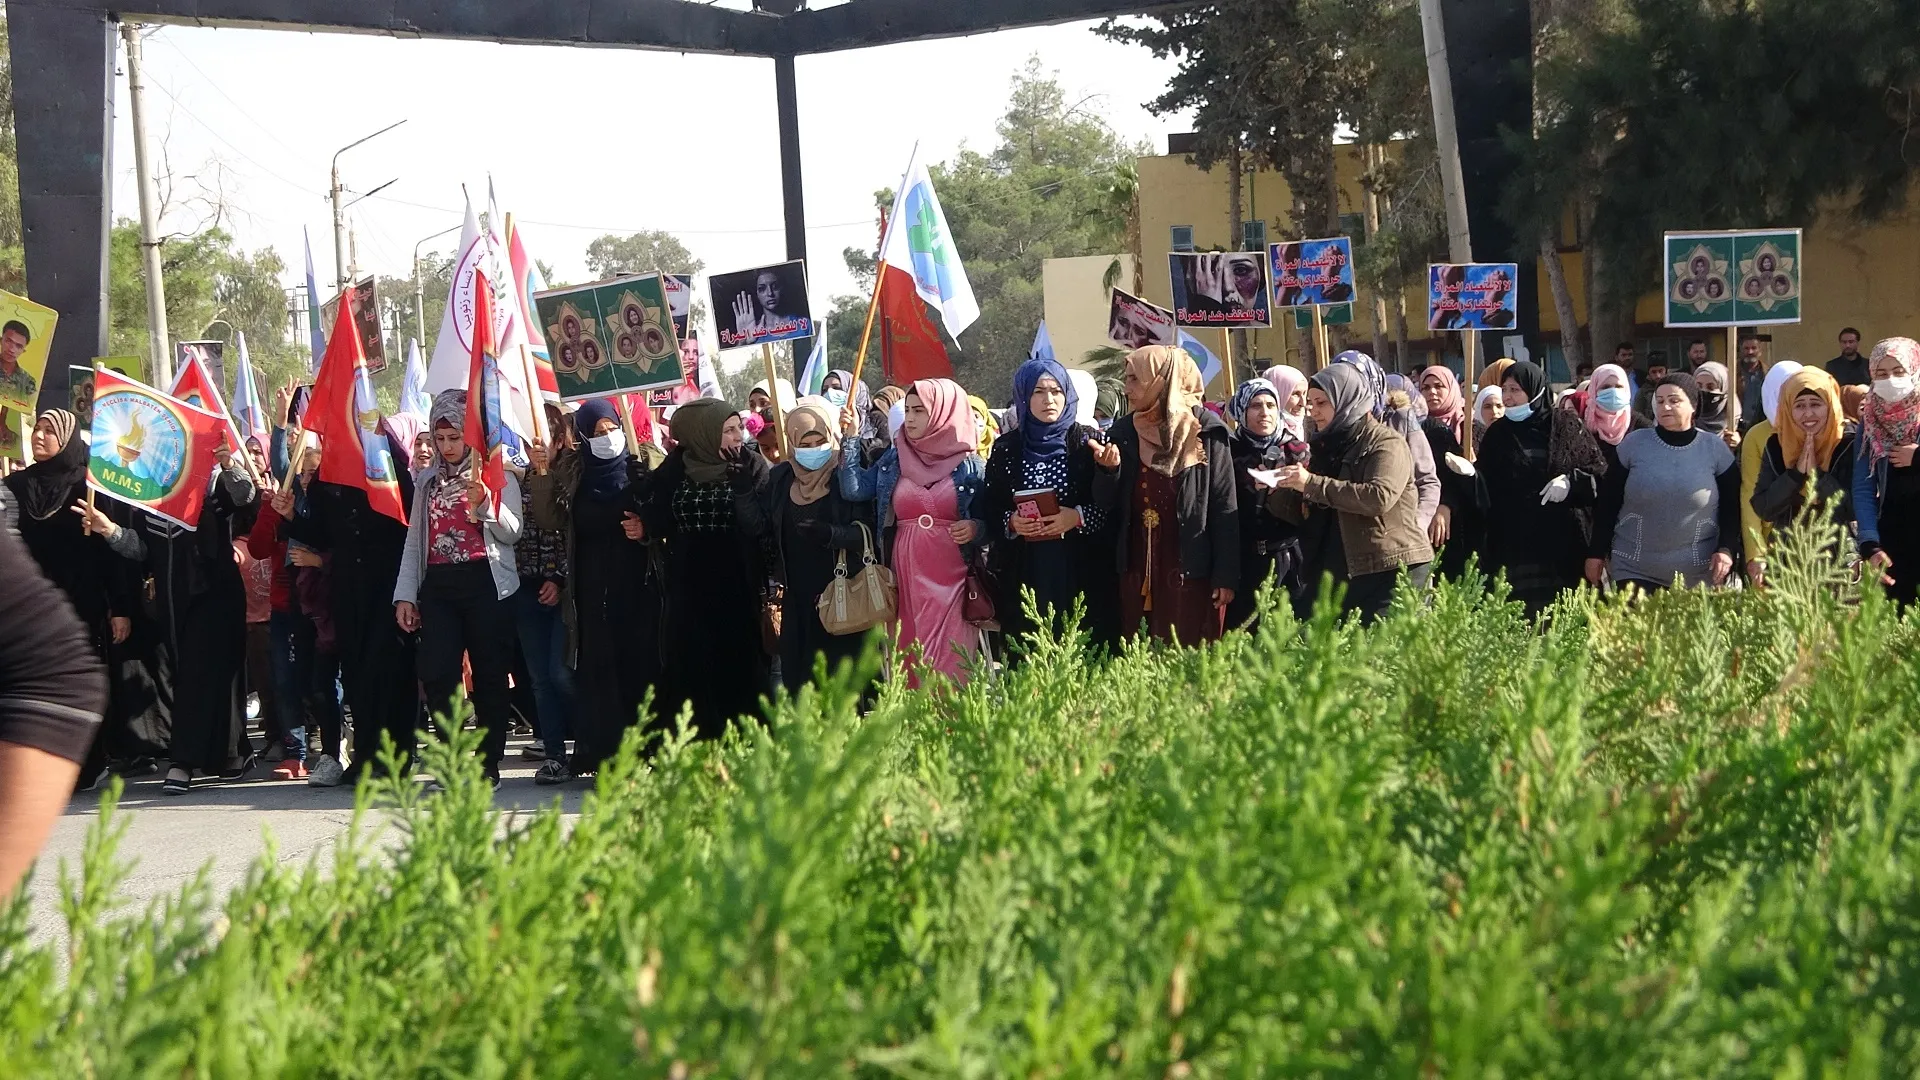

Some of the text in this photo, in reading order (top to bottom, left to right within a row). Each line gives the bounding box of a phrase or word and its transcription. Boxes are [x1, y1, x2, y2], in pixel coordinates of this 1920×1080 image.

[1338, 254, 1346, 265] لا
[1503, 280, 1511, 291] لا
[1177, 307, 1265, 323] لا للعنف ضد المرأة
[720, 317, 808, 344] لا للعنف ضد المرأة
[102, 468, 142, 495] M.M.Ş
